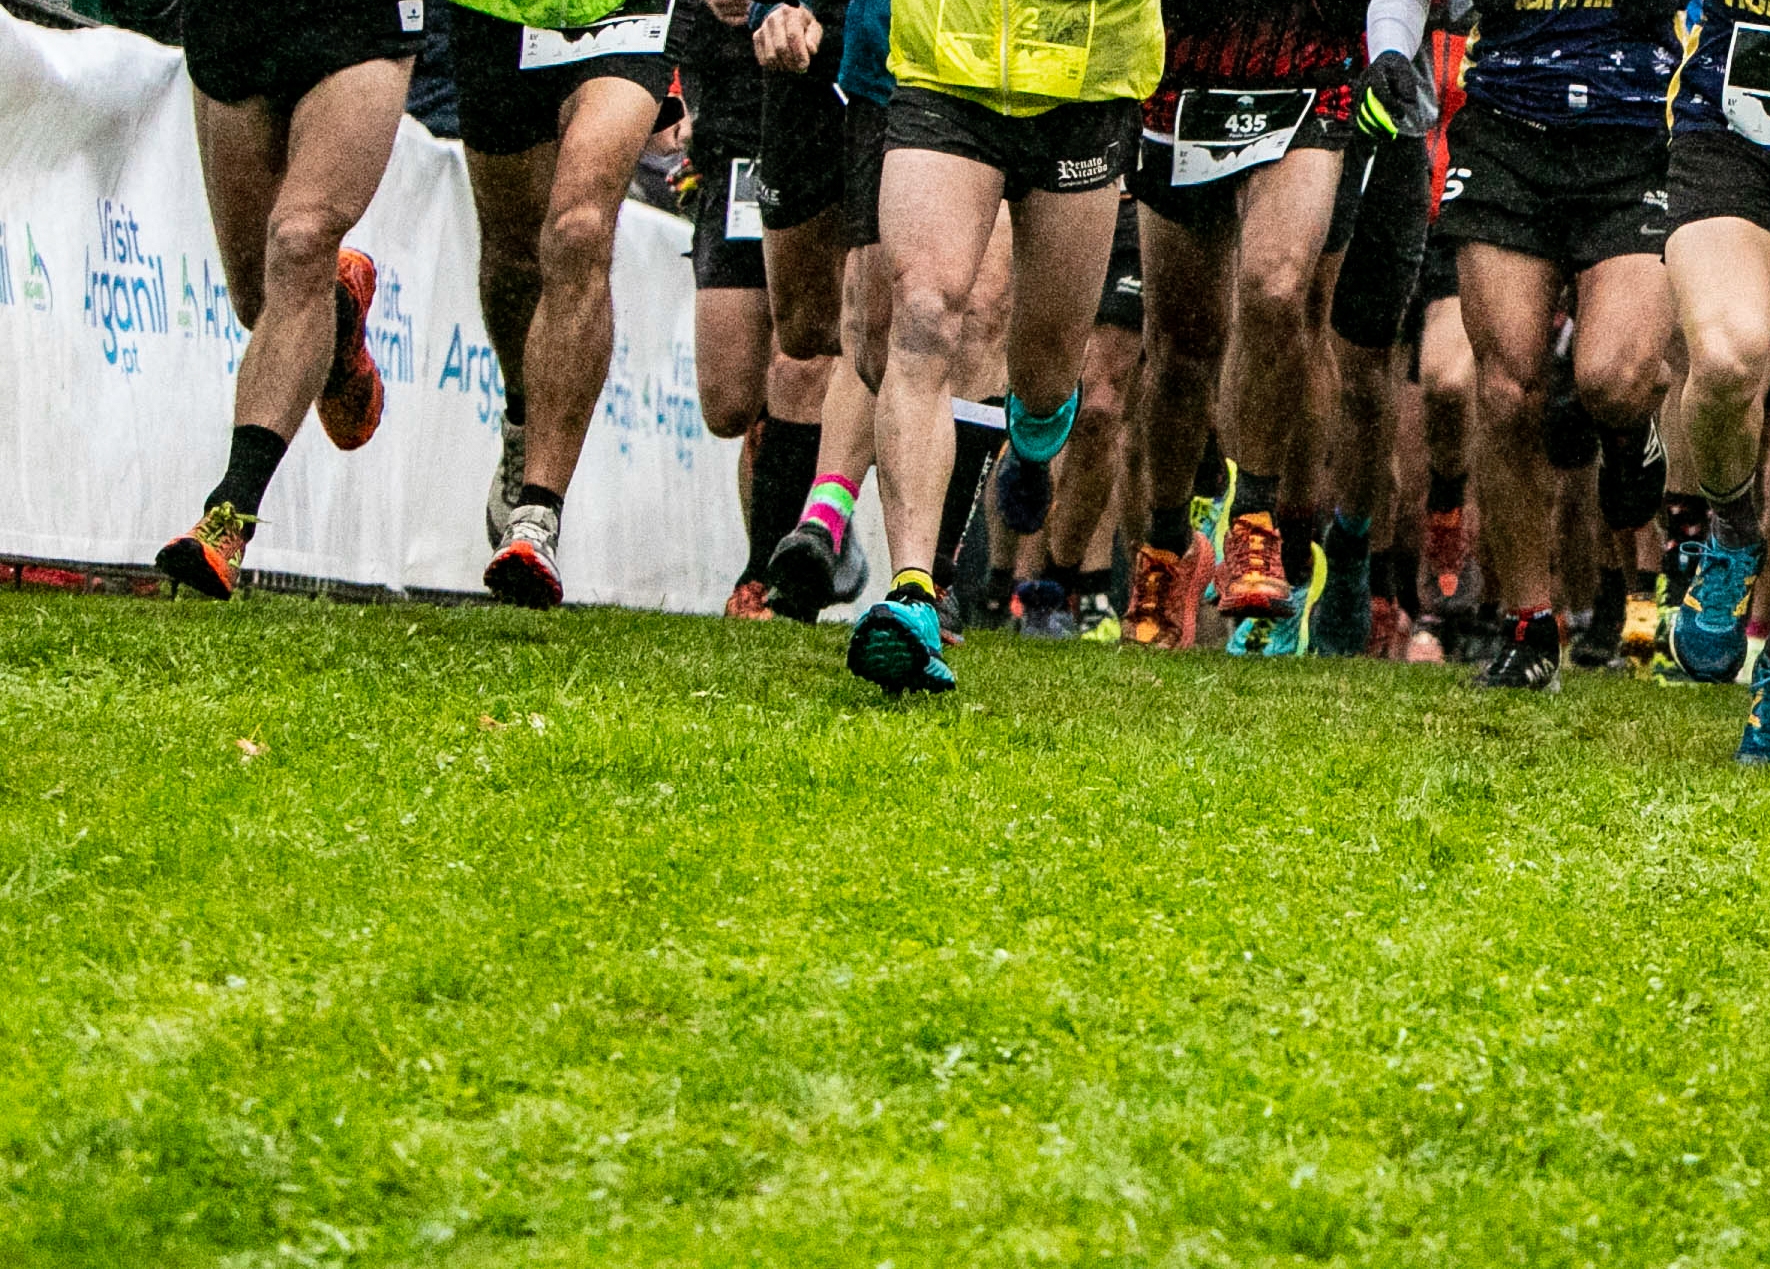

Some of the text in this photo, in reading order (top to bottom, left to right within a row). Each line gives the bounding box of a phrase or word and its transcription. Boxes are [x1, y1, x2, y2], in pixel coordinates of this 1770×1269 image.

[1224, 113, 1268, 133] 435
[97, 196, 145, 265] Visit
[83, 244, 169, 366] Arganil
